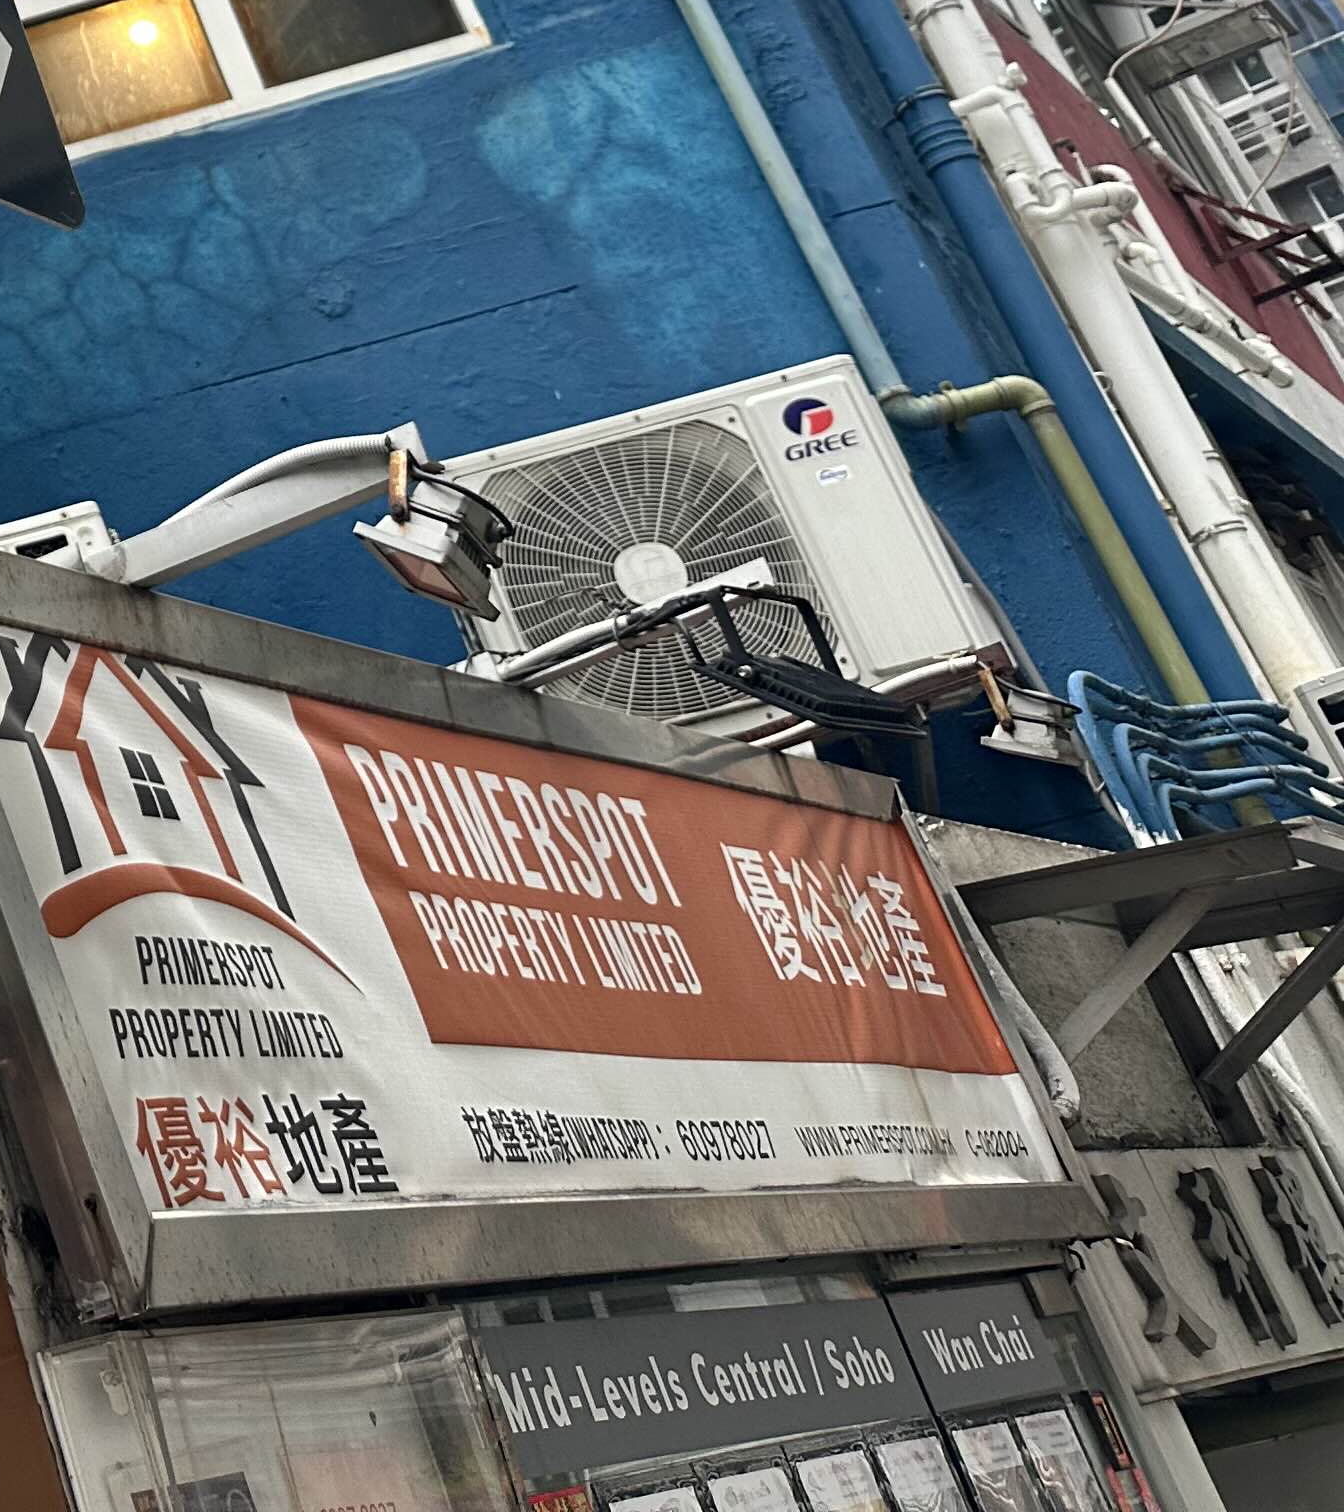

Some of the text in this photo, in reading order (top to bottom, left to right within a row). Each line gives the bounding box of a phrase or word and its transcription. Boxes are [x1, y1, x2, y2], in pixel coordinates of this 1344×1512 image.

[784, 428, 860, 462] GREE
[343, 742, 683, 908] PRIMERSPOT
[408, 890, 703, 996] PROPERTY LIMITED
[719, 840, 948, 999] 優裕地產
[134, 934, 286, 991] PRIMERSPOT
[108, 1007, 345, 1060] PROPERTY LIMITED
[134, 1092, 400, 1209] 優裕地產
[674, 1118, 778, 1162] 60978027
[492, 1355, 688, 1434] Mid-Levels
[690, 1342, 807, 1406] Central
[823, 1335, 895, 1390] Soho
[923, 1314, 1035, 1375] Wan Chai
